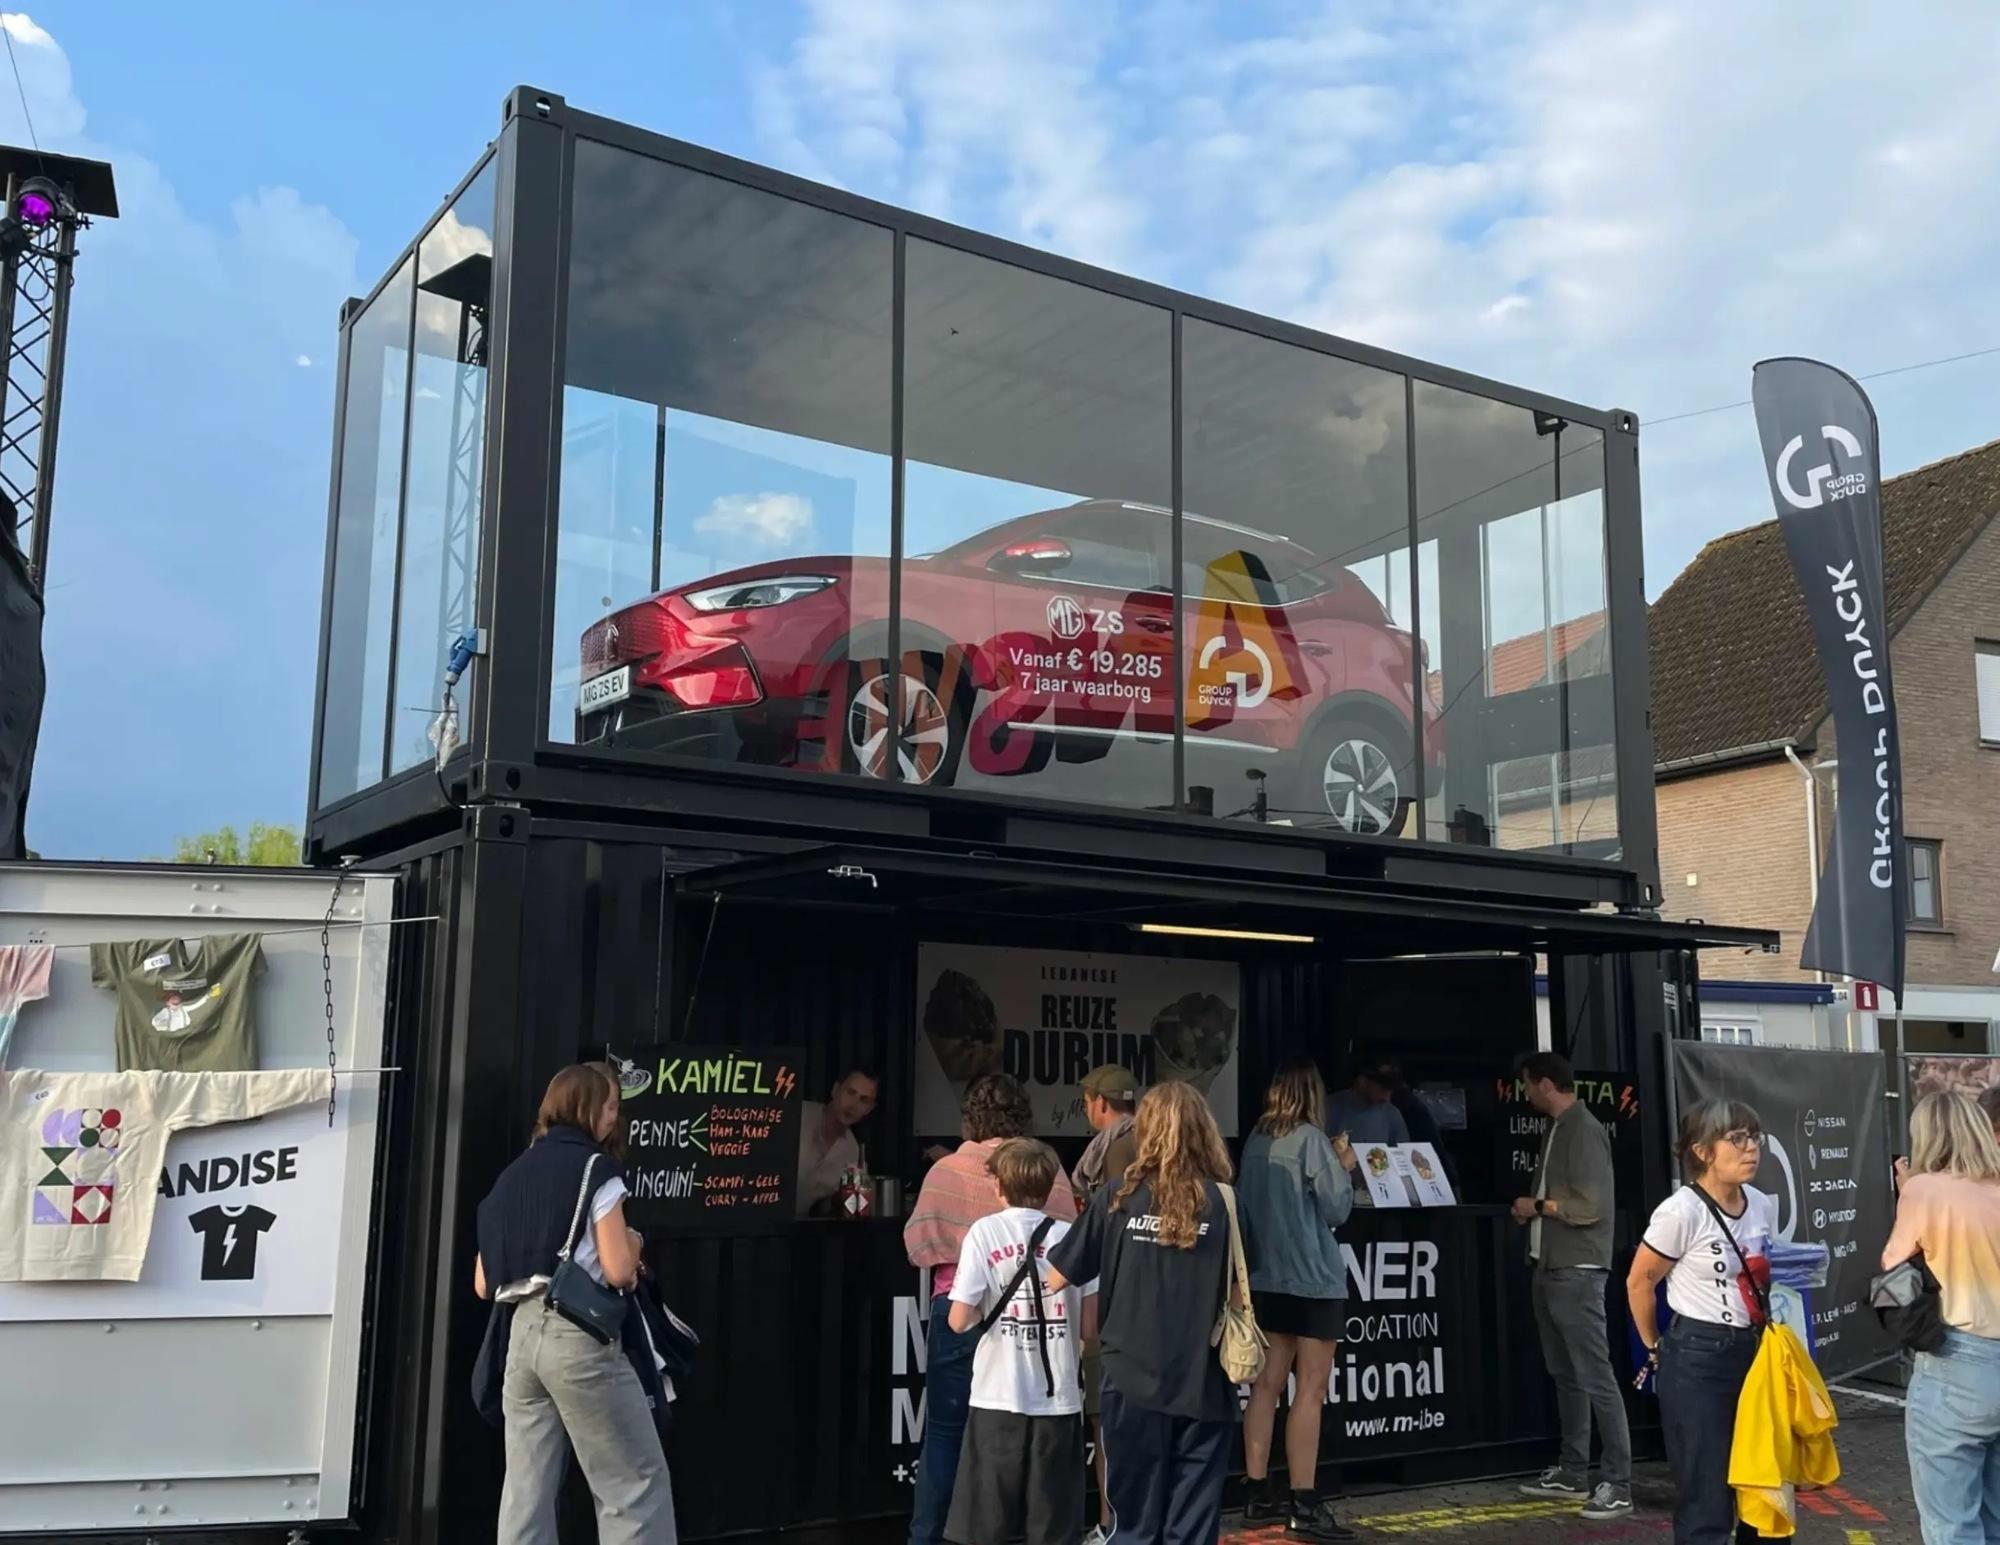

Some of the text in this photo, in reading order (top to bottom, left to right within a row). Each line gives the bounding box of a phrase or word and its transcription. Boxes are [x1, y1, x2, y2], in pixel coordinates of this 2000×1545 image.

[1048, 598, 1124, 637] MG ZS
[1009, 648, 1162, 678] Vanaf € 19.285
[584, 671, 625, 704] MG ZS EV
[1020, 672, 1151, 703] 7 jaar waarborg
[1198, 684, 1232, 696] GROUP
[1199, 695, 1232, 706] DUYCK
[1041, 966, 1117, 983] LEBANESE
[1041, 994, 1117, 1030] REUZE
[656, 1053, 771, 1094] KAMIEL
[628, 1119, 690, 1148] PENNE
[1817, 1117, 1846, 1127] NISSAN
[1820, 1147, 1849, 1159] RENAULT
[157, 1146, 299, 1199] ANDISE
[1825, 1178, 1858, 1191] DACIA
[1126, 1214, 1210, 1235] AUTOE
[1339, 1240, 1439, 1301] NER
[1710, 1242, 1733, 1323] SONIC
[1021, 1326, 1055, 1341] YEAS
[1336, 1312, 1438, 1343] OCATION
